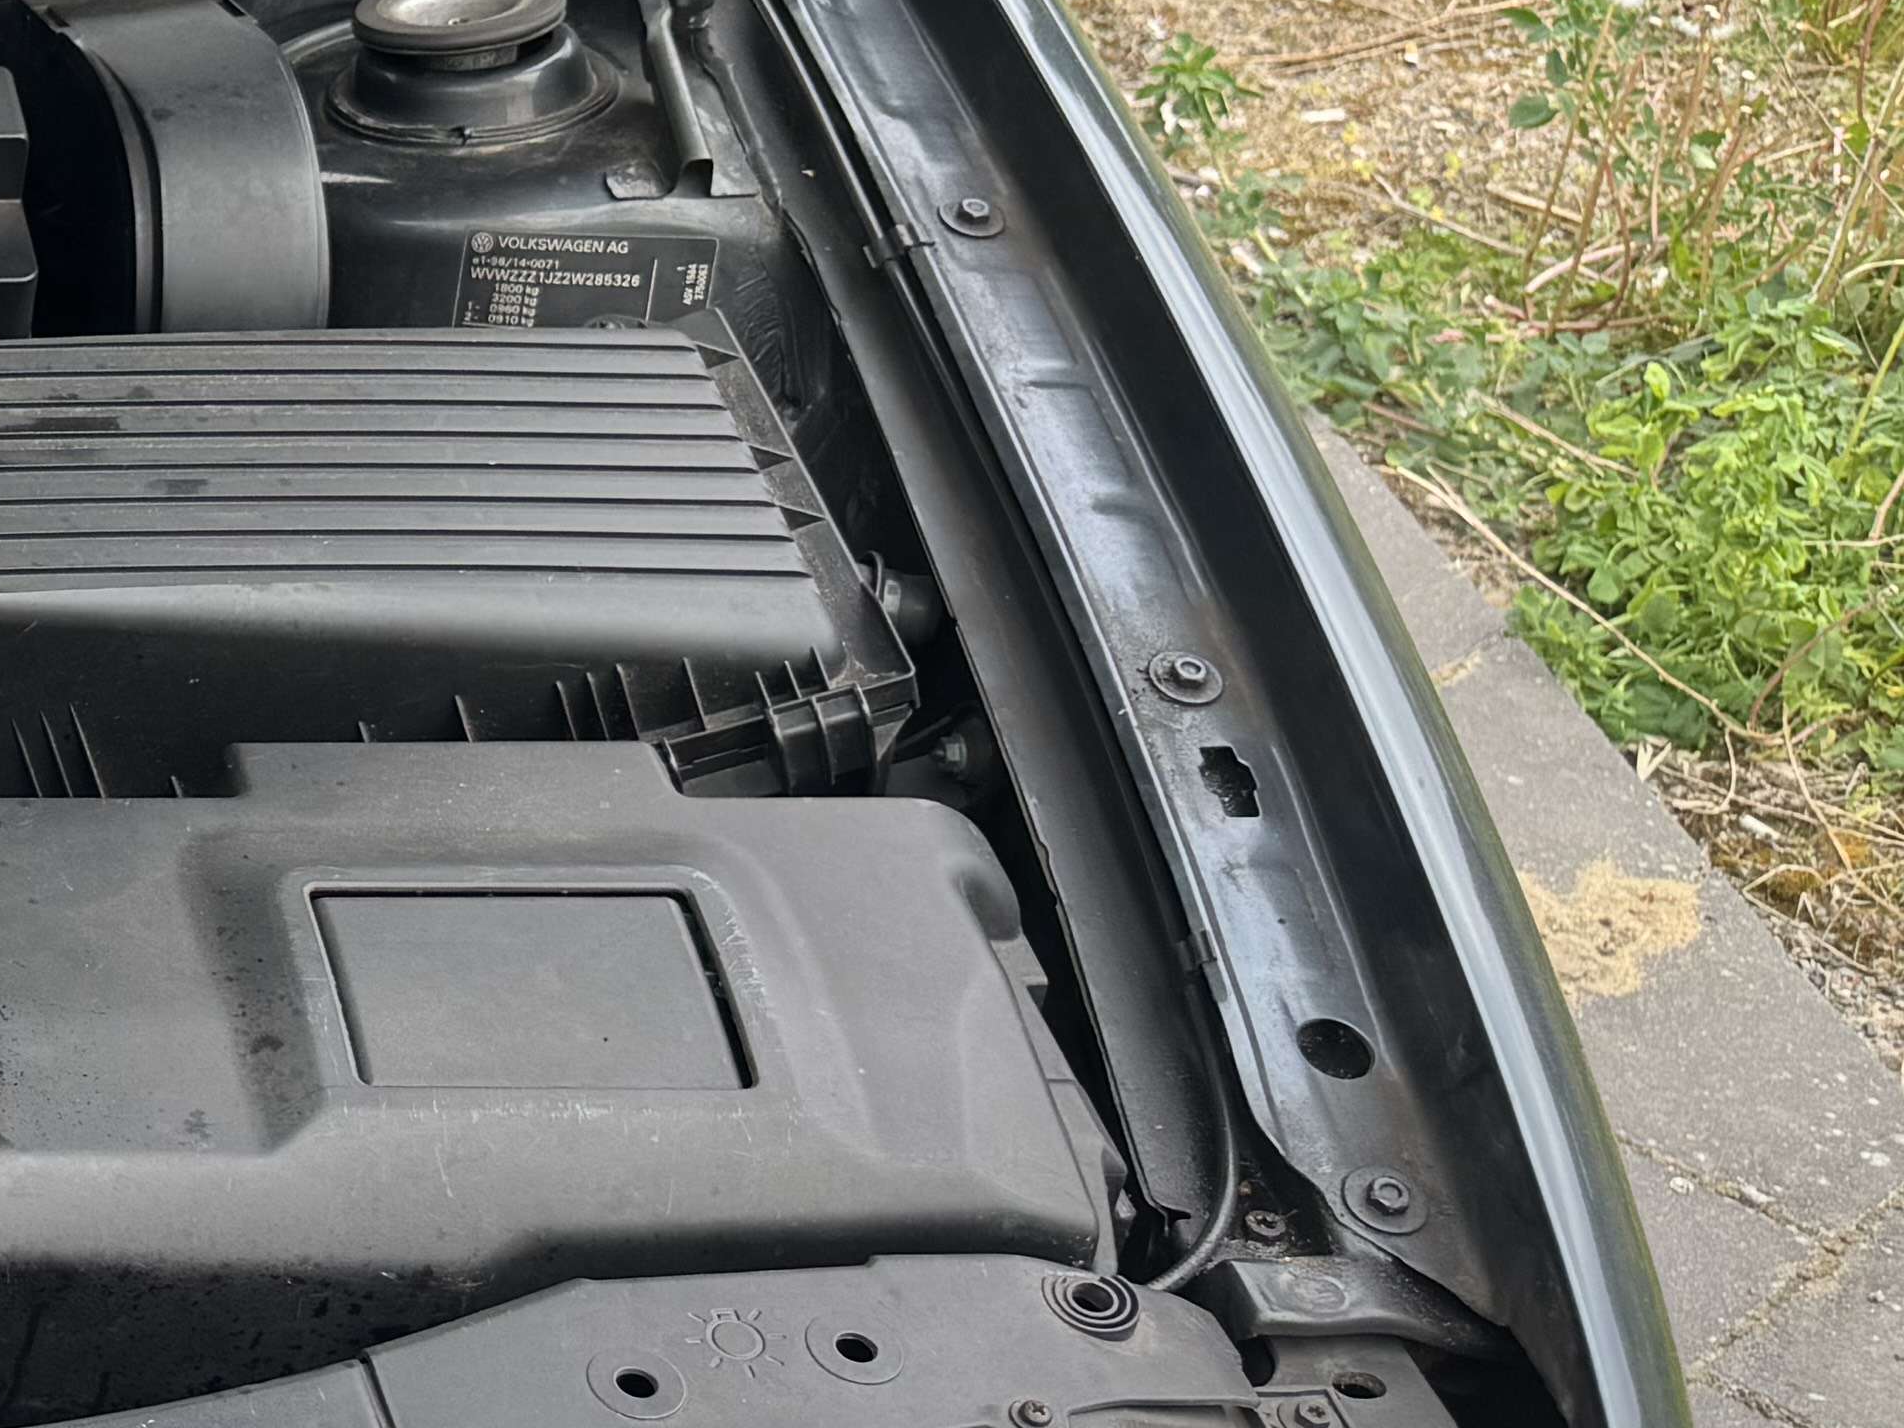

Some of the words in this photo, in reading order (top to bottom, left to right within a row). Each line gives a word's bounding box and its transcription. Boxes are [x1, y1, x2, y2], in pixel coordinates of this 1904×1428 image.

[499, 235, 605, 253] VOLKSWAGEN
[606, 241, 629, 254] AG
[495, 283, 524, 293] 1800
[526, 285, 539, 296] kg
[492, 293, 522, 304] 3200
[524, 295, 537, 307] kg
[522, 306, 536, 317] kg
